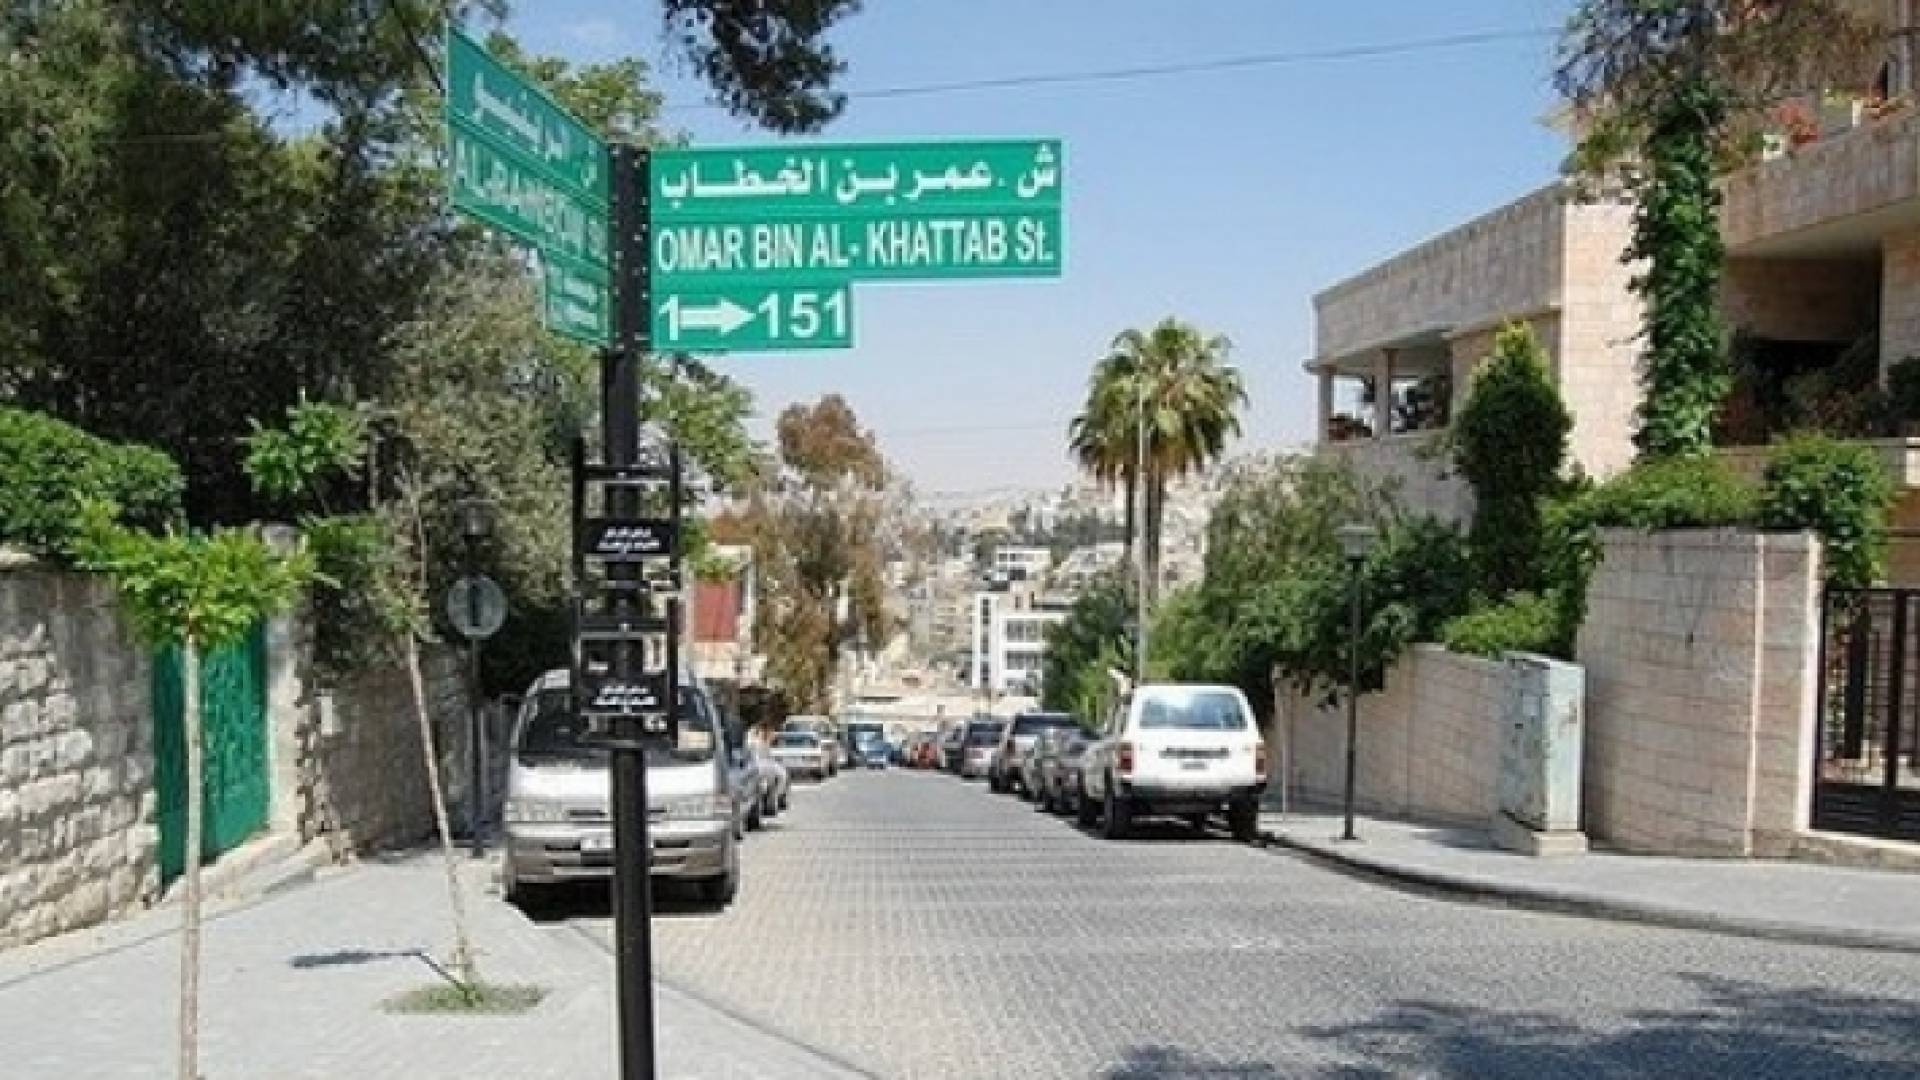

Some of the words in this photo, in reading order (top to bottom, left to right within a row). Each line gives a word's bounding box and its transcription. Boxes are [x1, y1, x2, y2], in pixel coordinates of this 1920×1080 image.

[661, 156, 830, 209] الخطاب
[836, 158, 898, 206] بن
[902, 161, 992, 201] عمر
[658, 226, 743, 273] OMAR
[755, 223, 803, 269] BIN
[866, 219, 1008, 267] KHATTAB
[1015, 216, 1054, 264] St.
[658, 294, 680, 341] 1
[758, 289, 847, 339] 151
